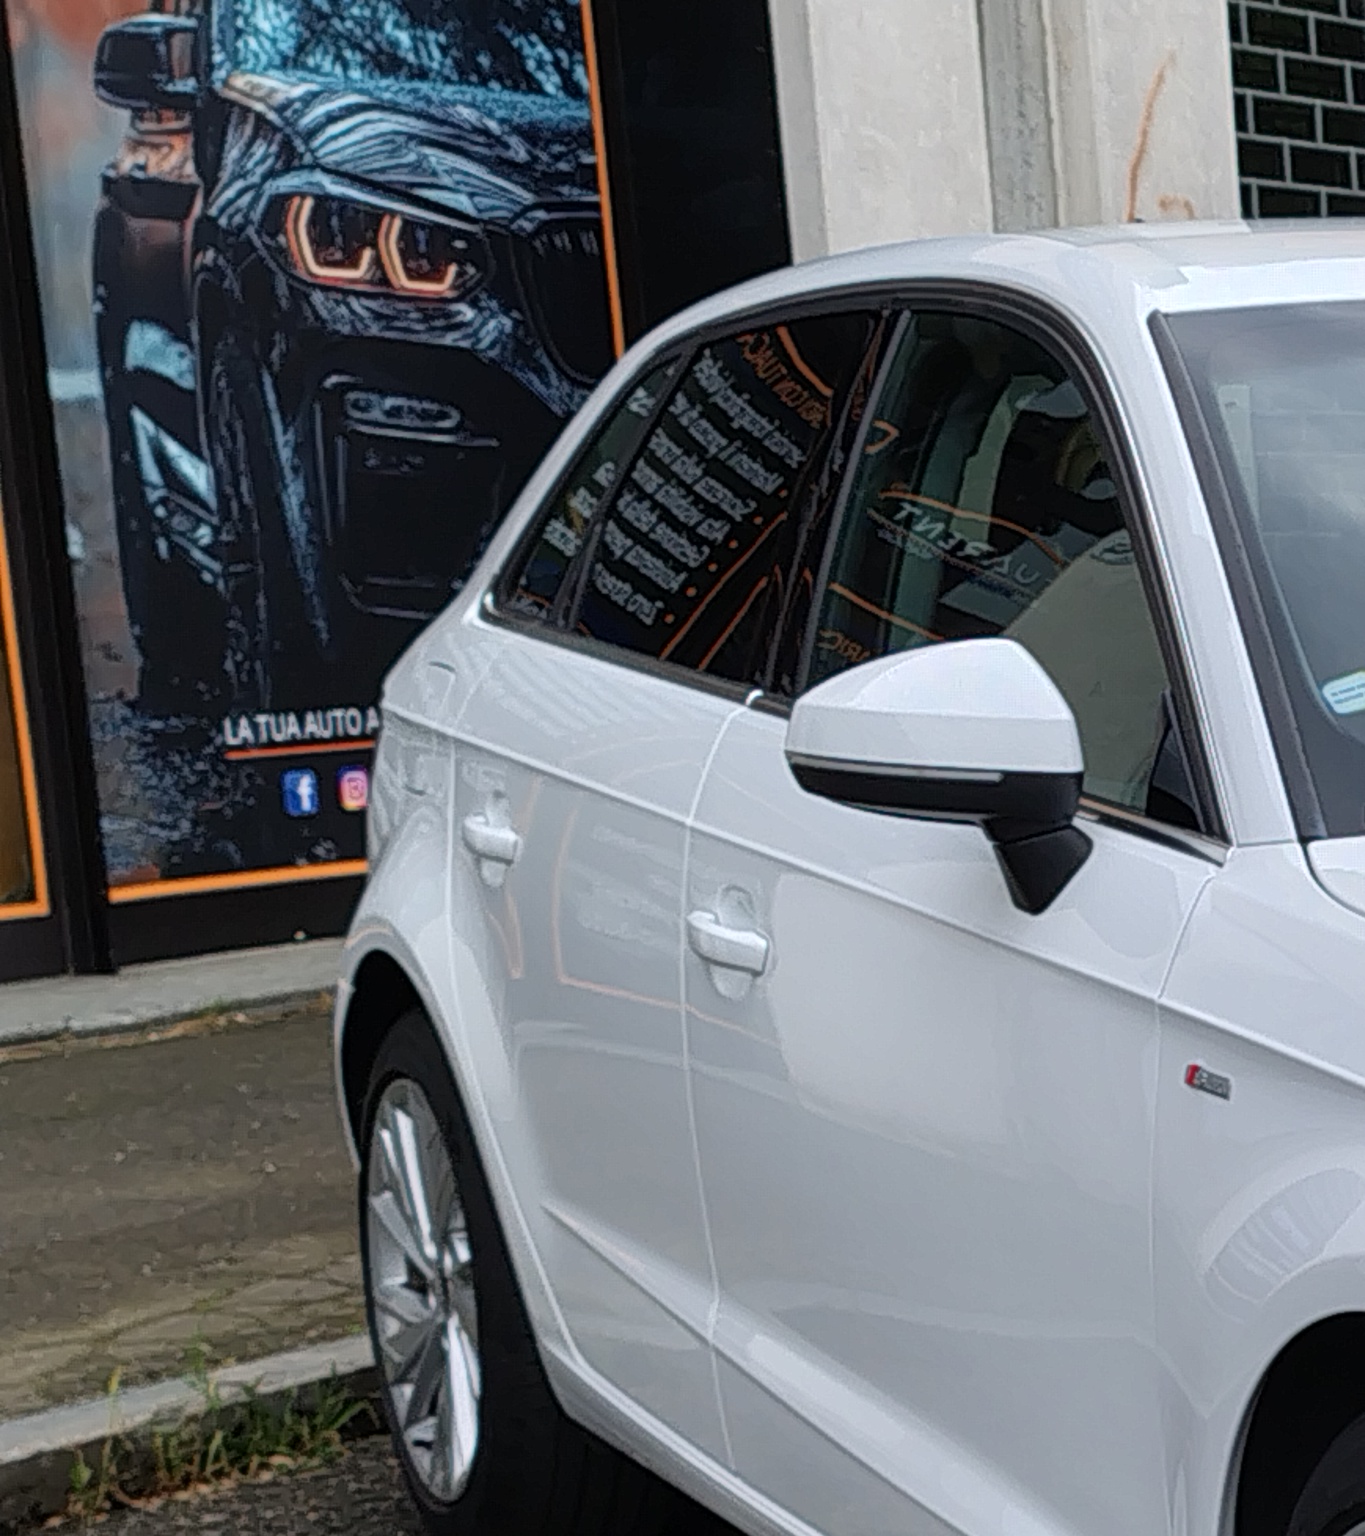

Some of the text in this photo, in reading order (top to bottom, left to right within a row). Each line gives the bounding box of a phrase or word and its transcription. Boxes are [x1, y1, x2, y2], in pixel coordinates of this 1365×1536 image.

[223, 714, 254, 745] LA
[253, 711, 301, 743] TUA
[304, 707, 362, 740] AUTO
